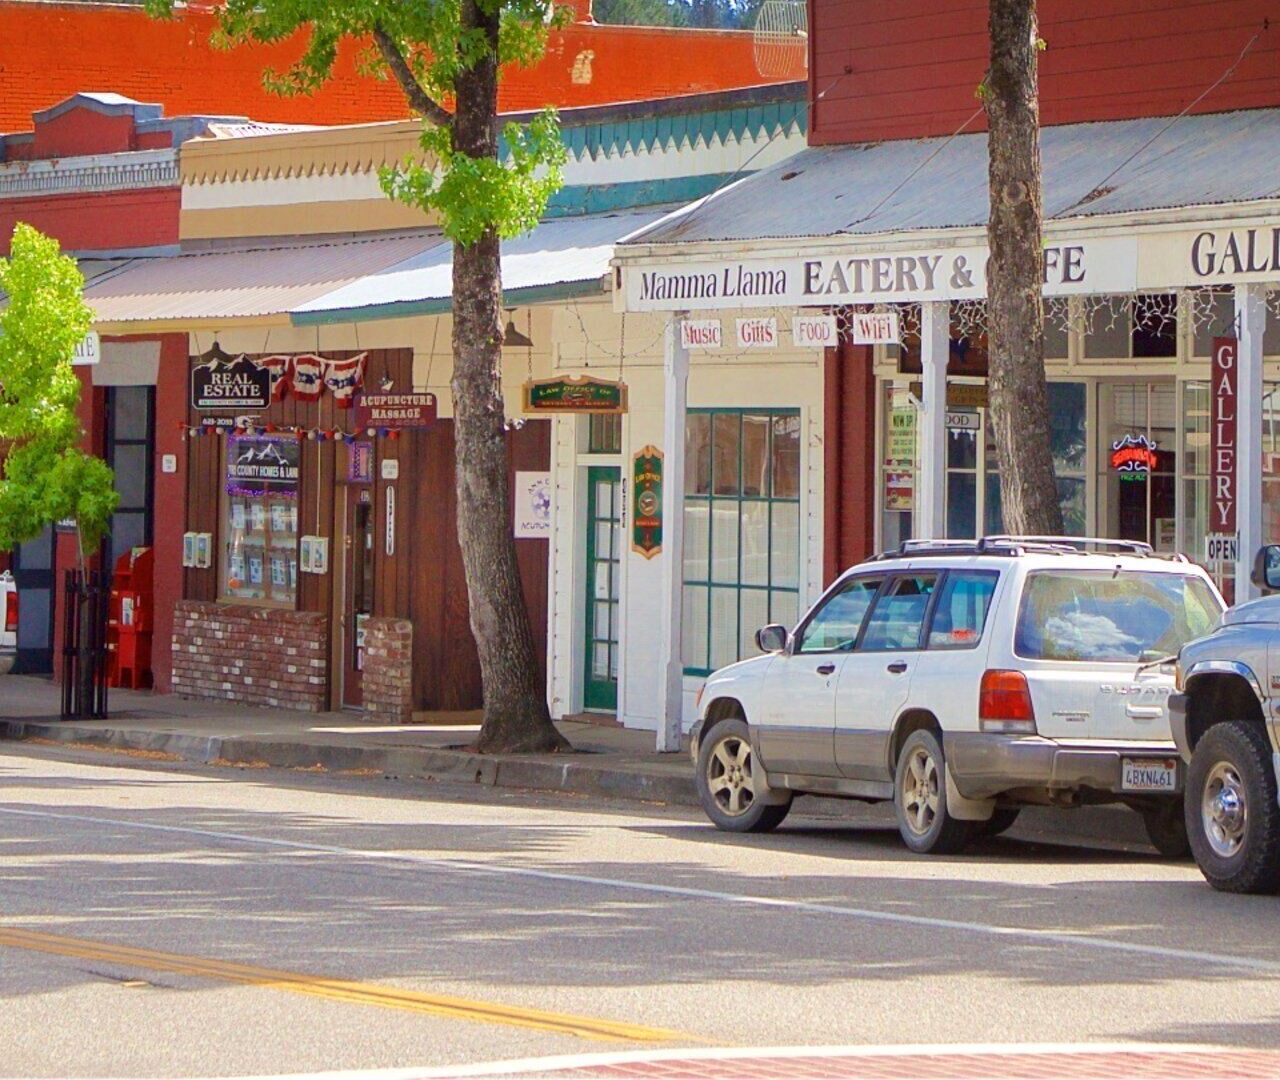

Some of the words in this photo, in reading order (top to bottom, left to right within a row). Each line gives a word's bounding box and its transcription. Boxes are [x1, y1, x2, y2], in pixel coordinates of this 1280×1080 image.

[640, 271, 717, 300] Mamma
[722, 265, 787, 297] Llama
[802, 255, 943, 295] EATERY
[949, 255, 976, 290] &
[683, 324, 719, 345] Music
[741, 322, 773, 344] Gifts
[799, 323, 830, 341] FOOD
[860, 318, 893, 340] WiFi
[211, 372, 253, 385] REAL
[203, 384, 260, 396] ESTATE
[539, 387, 559, 396] LAW
[563, 385, 595, 393] OFFICE
[359, 395, 433, 407] ACUPUNCTURE
[371, 408, 420, 419] MASSAGE
[1215, 346, 1235, 525] GALLERY
[237, 465, 259, 477] COUNTY
[260, 465, 278, 477] HOMES
[1208, 539, 1236, 560] OPEN
[1126, 771, 1172, 786] 4BXN461
